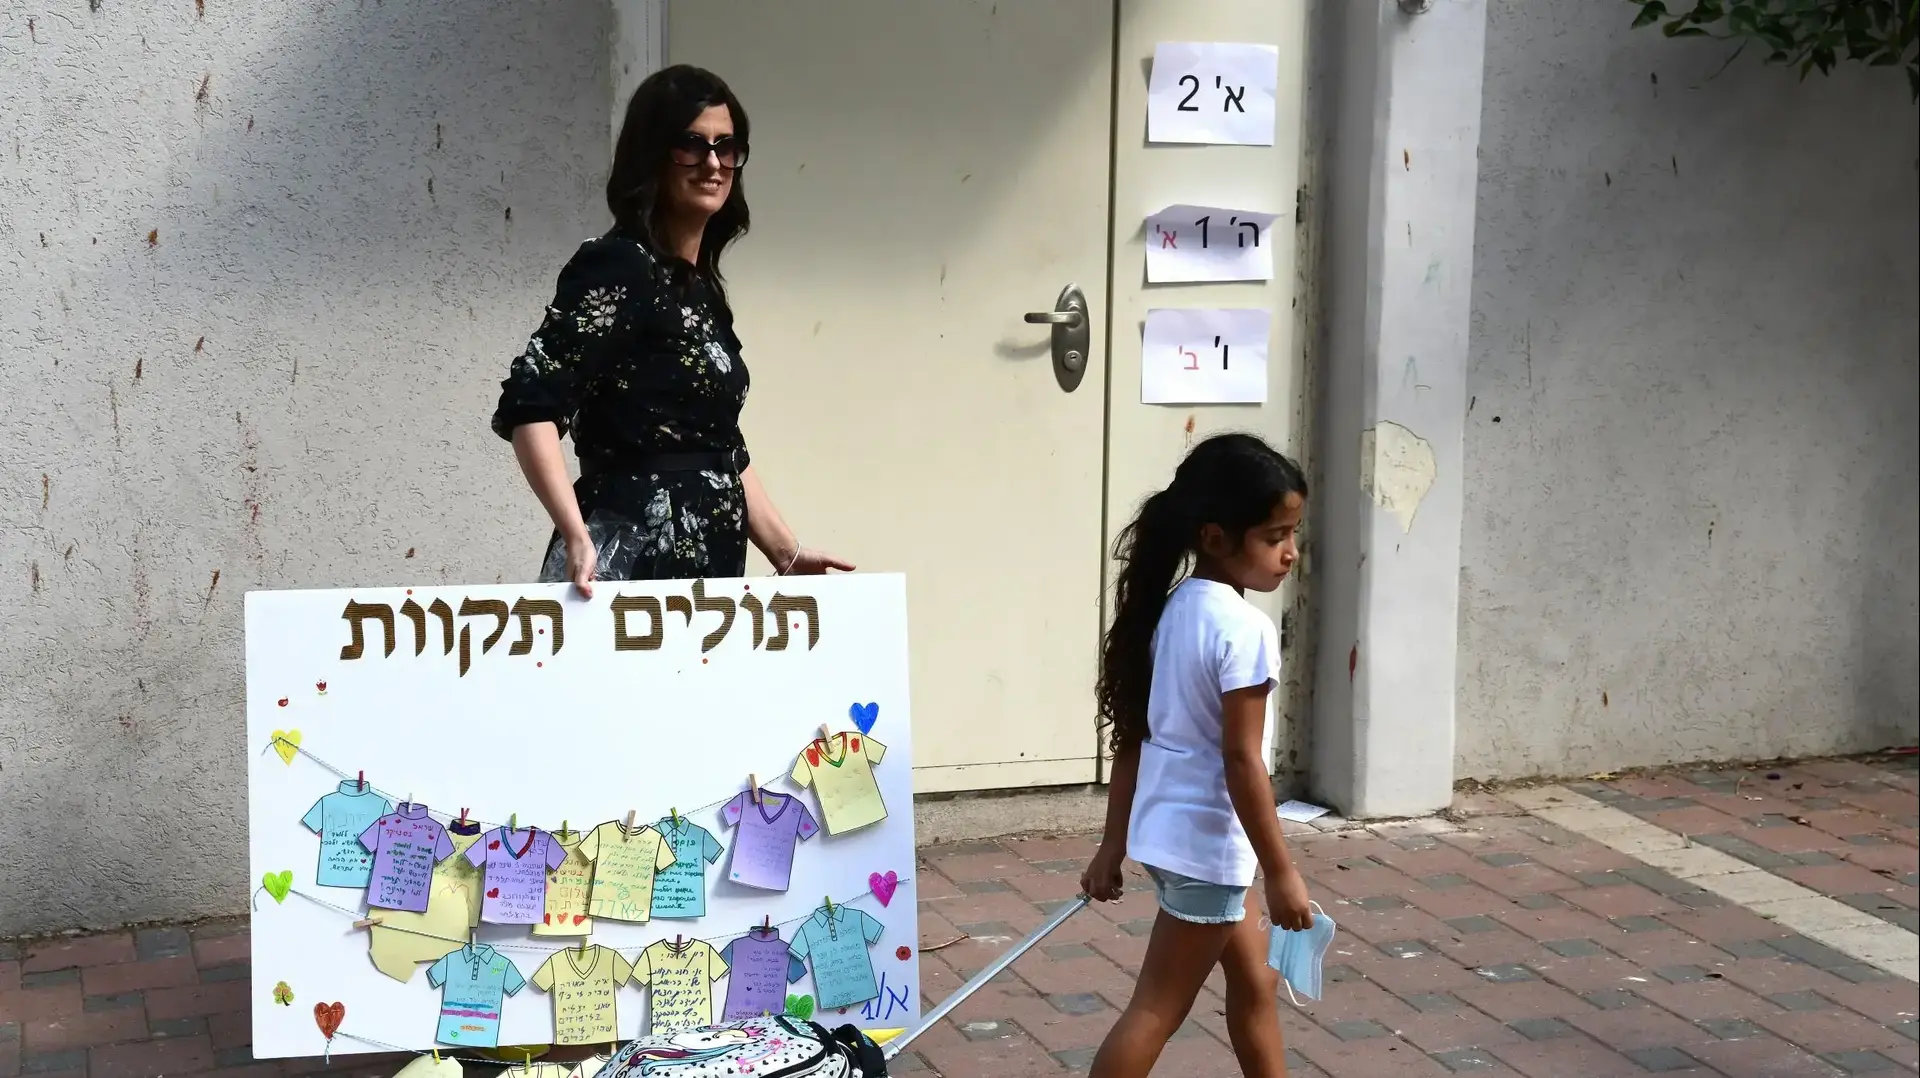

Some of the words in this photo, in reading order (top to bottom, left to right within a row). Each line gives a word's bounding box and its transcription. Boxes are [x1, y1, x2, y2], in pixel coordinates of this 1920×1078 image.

[1177, 74, 1200, 112] 2
[1215, 75, 1245, 113] א'
[1156, 224, 1178, 249] א'
[1194, 215, 1210, 248] 1
[1230, 216, 1260, 248] ה'
[1178, 345, 1200, 371] ב'
[1214, 335, 1229, 370] ו'
